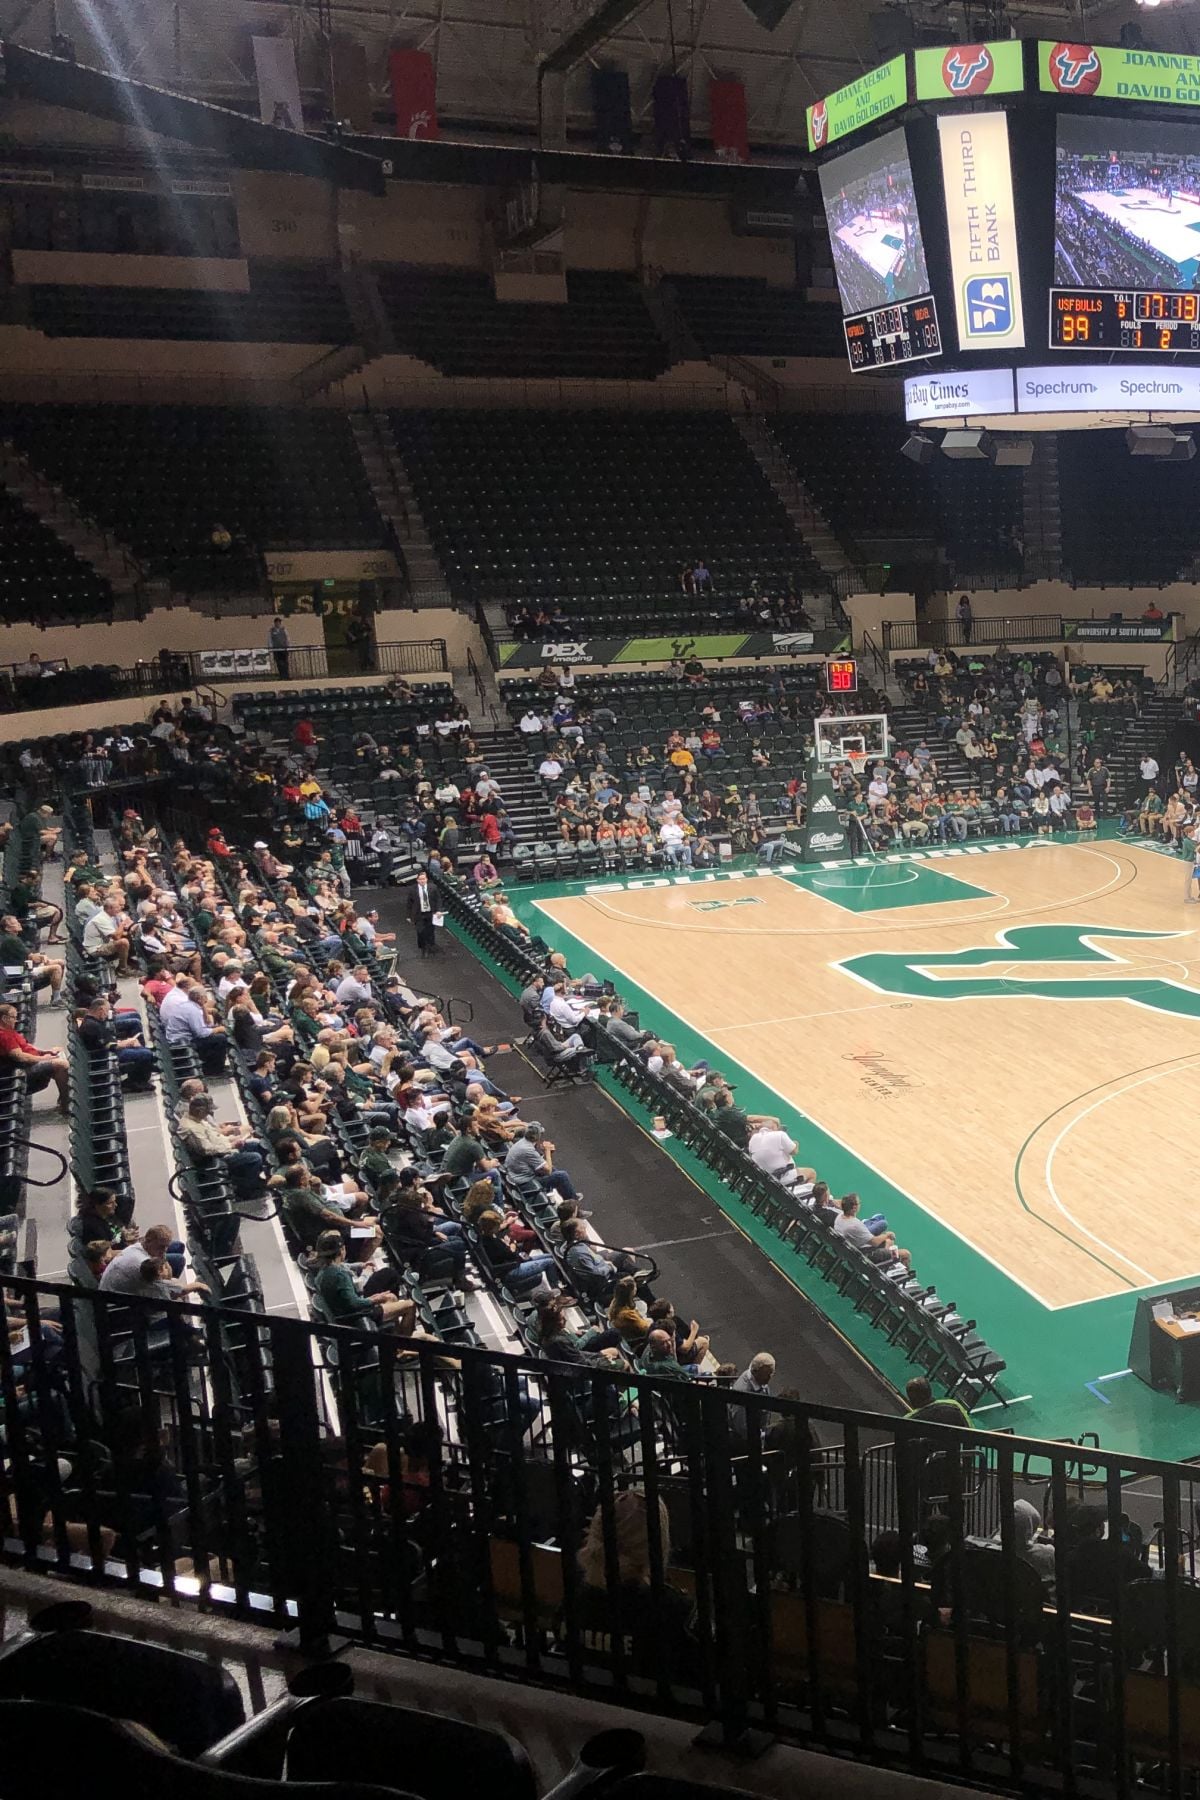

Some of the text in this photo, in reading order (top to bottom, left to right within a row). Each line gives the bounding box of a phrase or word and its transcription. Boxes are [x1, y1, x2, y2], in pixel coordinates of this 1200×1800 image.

[1121, 52, 1193, 70] JOANNE
[835, 64, 892, 108] JOANNE NELSON
[1116, 82, 1171, 100] DAVID
[854, 90, 871, 109] AND
[834, 95, 896, 136] DAVID GOLDSTEIN
[960, 130, 983, 262] FIFTH THIRD
[984, 202, 1001, 262] BANK
[1118, 302, 1126, 319] 3
[1143, 294, 1197, 320] 17:13
[1063, 315, 1089, 341] 39
[1120, 321, 1142, 330] FOULS
[1155, 321, 1178, 331] PERIOD
[1160, 330, 1171, 349] 2
[929, 380, 969, 401] Times
[1025, 380, 1094, 398] Spectrum
[1119, 379, 1180, 398] Spectrum
[1077, 627, 1162, 637] UNIVERSITY OF SOUTH FLORIDA
[540, 642, 589, 658] DEX
[831, 663, 853, 673] 17:13
[832, 673, 851, 689] 30
[812, 804, 837, 813] adidas
[820, 838, 1063, 870] FLORIDA
[584, 865, 799, 895] SOUTH
